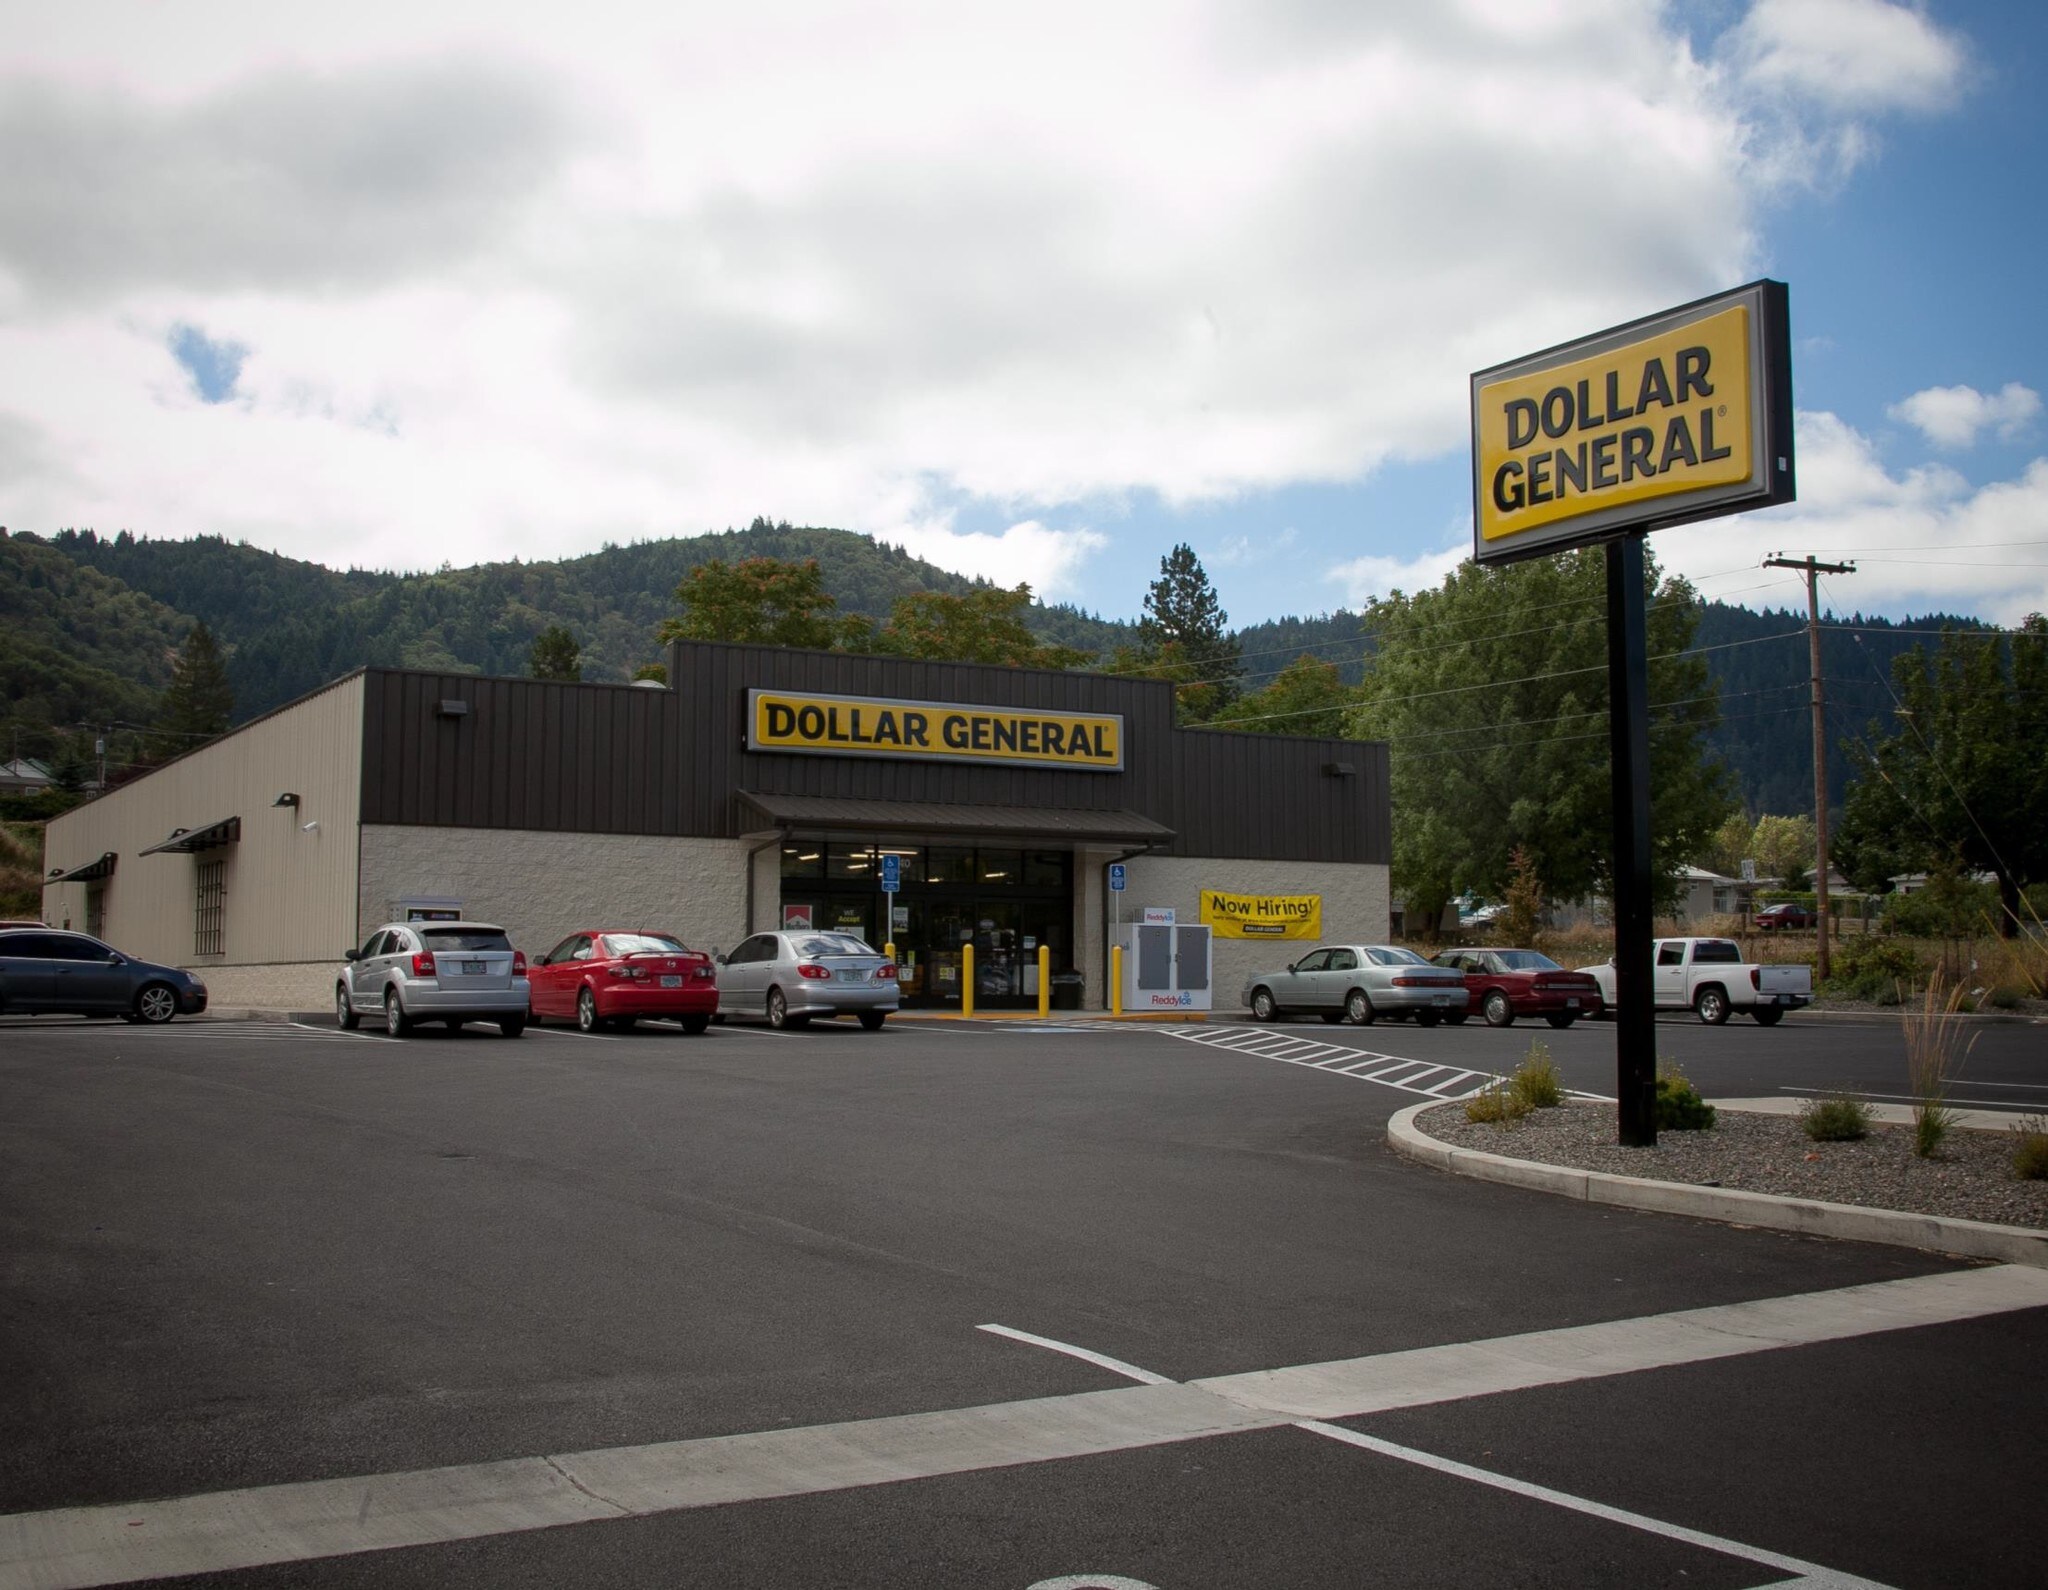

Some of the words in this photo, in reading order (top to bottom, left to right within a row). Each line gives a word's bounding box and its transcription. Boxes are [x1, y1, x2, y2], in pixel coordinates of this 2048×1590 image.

[1504, 346, 1714, 450] DOLLAR
[1493, 407, 1731, 512] GENERAL
[765, 703, 930, 747] DOLLAR
[943, 715, 1114, 758] GENERAL
[1212, 895, 1251, 914] Now
[1257, 899, 1312, 918] Hiring!
